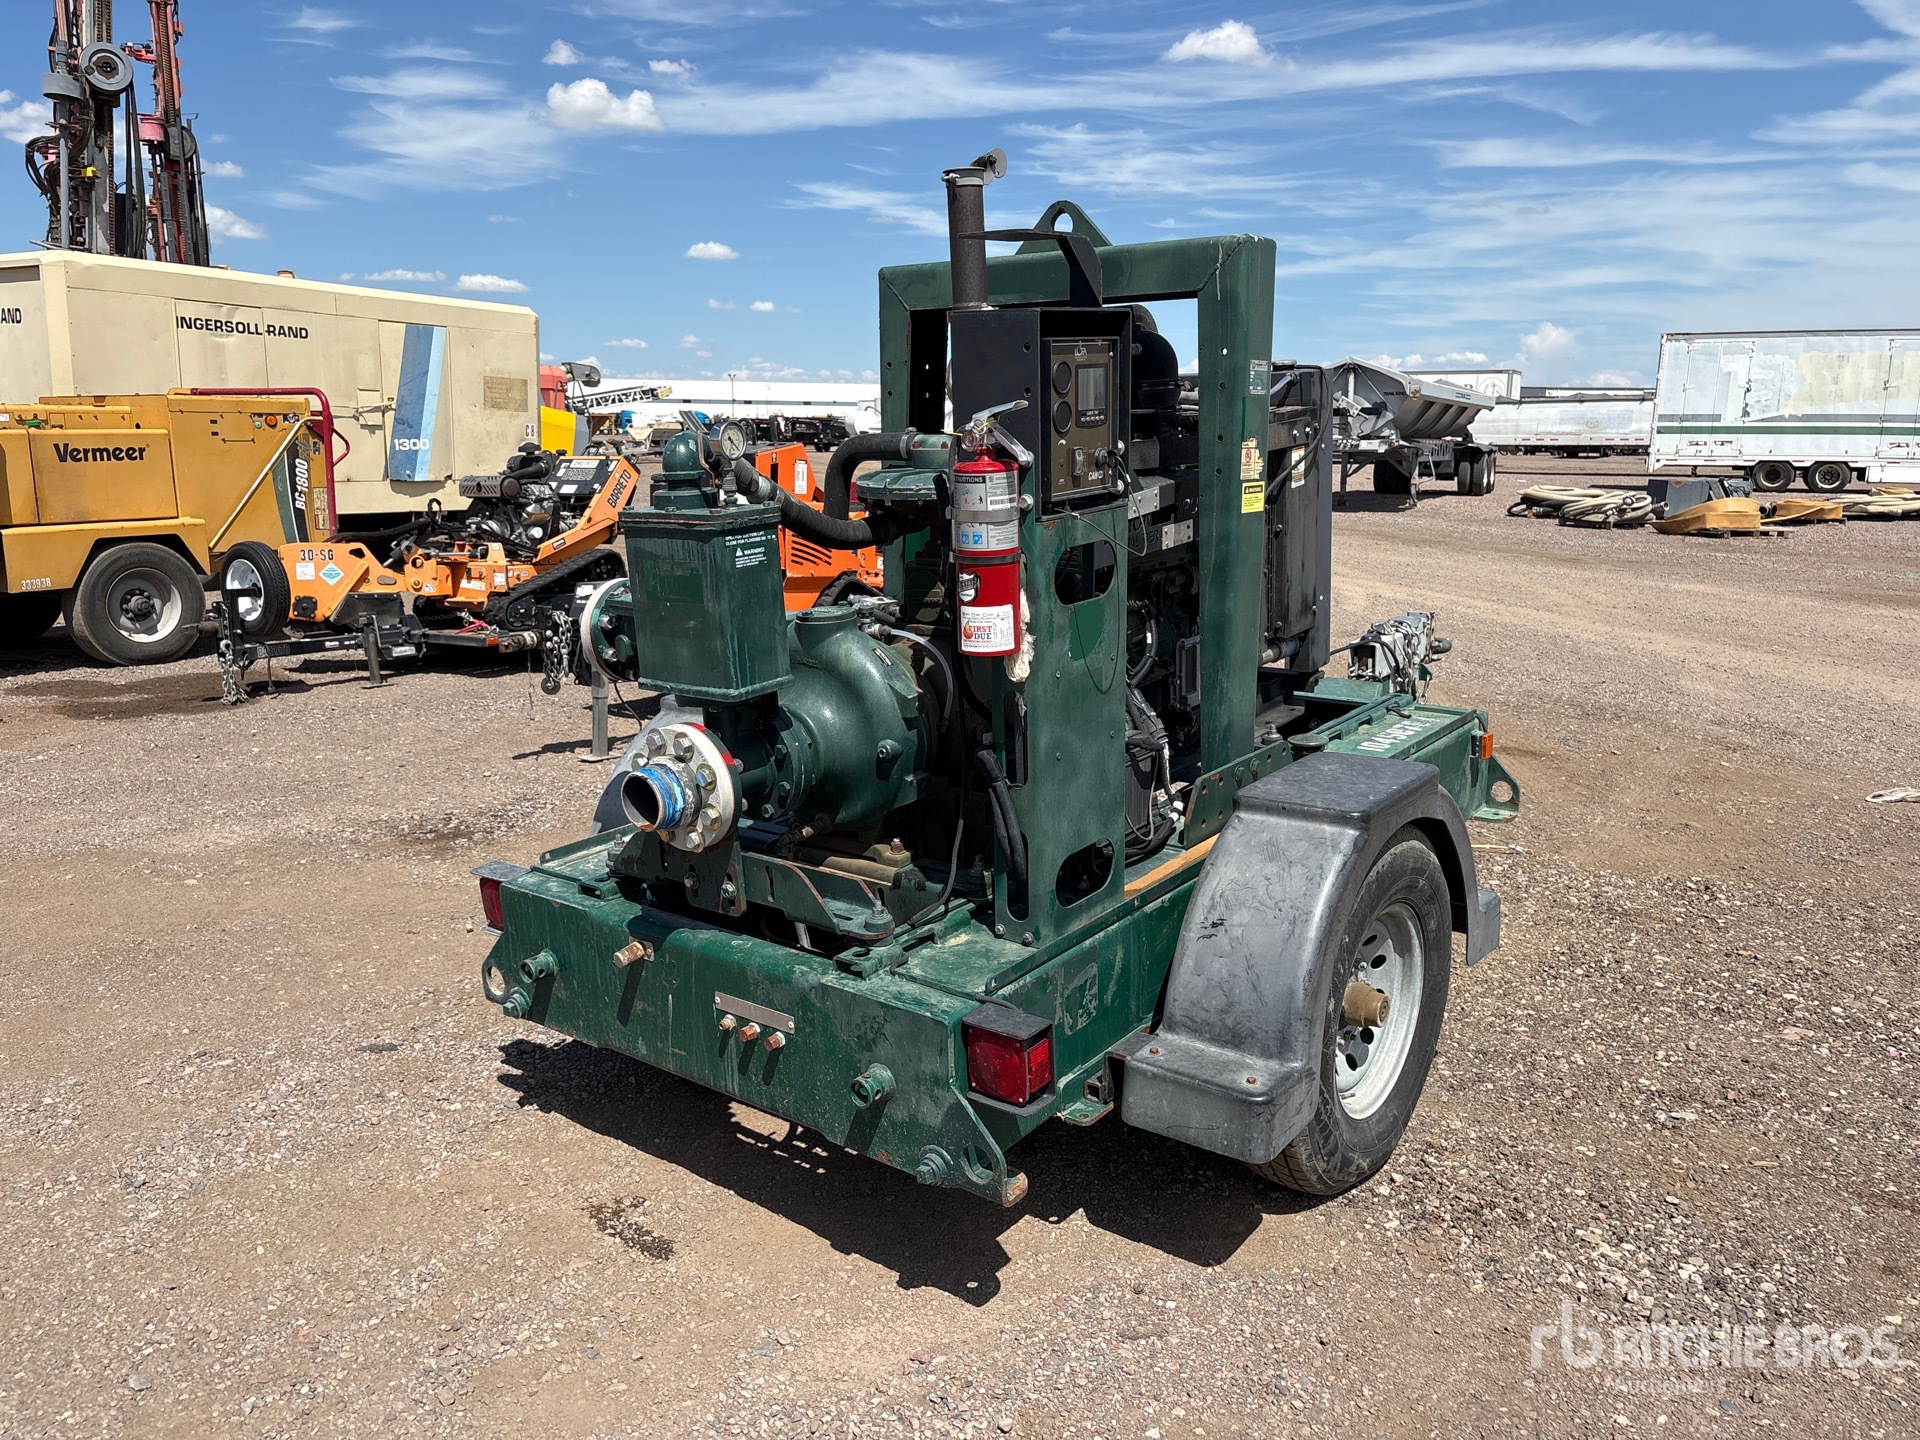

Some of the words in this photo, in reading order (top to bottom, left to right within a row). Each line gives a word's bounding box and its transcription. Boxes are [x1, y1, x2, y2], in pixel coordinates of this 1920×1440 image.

[393, 438, 430, 451] 1300
[53, 443, 147, 463] Vermeer
[607, 469, 632, 509] BARRETO
[299, 549, 334, 561] 30-SG
[21, 577, 51, 590] 333938
